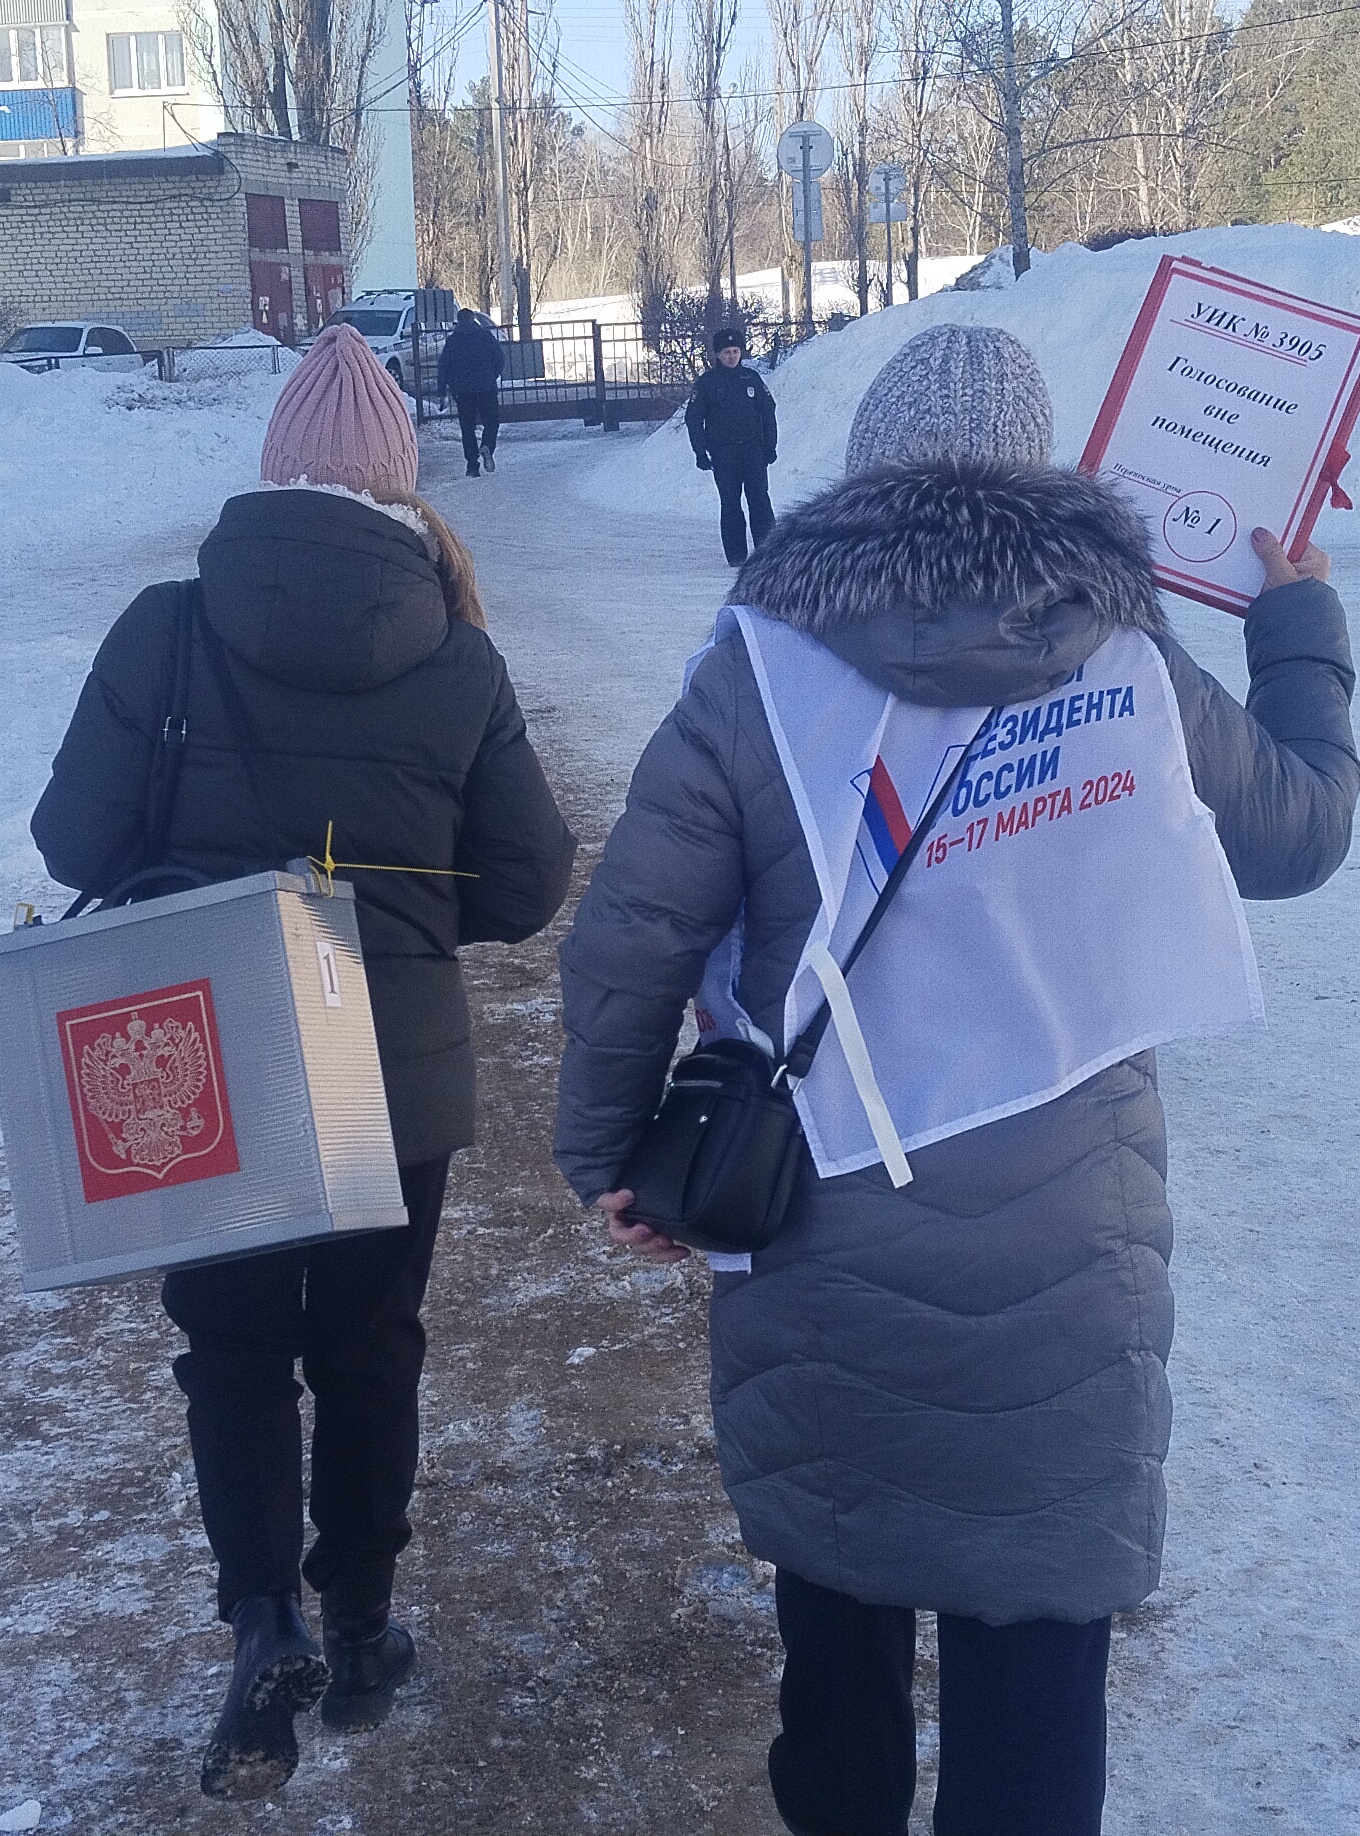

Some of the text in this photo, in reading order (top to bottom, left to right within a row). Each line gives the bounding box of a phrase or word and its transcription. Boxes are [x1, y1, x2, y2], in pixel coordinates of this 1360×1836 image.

[1191, 302, 1328, 362] УИК № 3905
[1166, 355, 1300, 415] Голосование
[1203, 402, 1241, 426] вне
[1150, 413, 1273, 469] помещения
[1172, 506, 1223, 536] № 1
[976, 686, 1135, 760] ЕЗИДЕНТА
[951, 746, 1061, 818] ОССИИ
[994, 786, 1073, 843] МАРТА
[1079, 769, 1137, 812] 2024
[323, 953, 338, 995] 1
